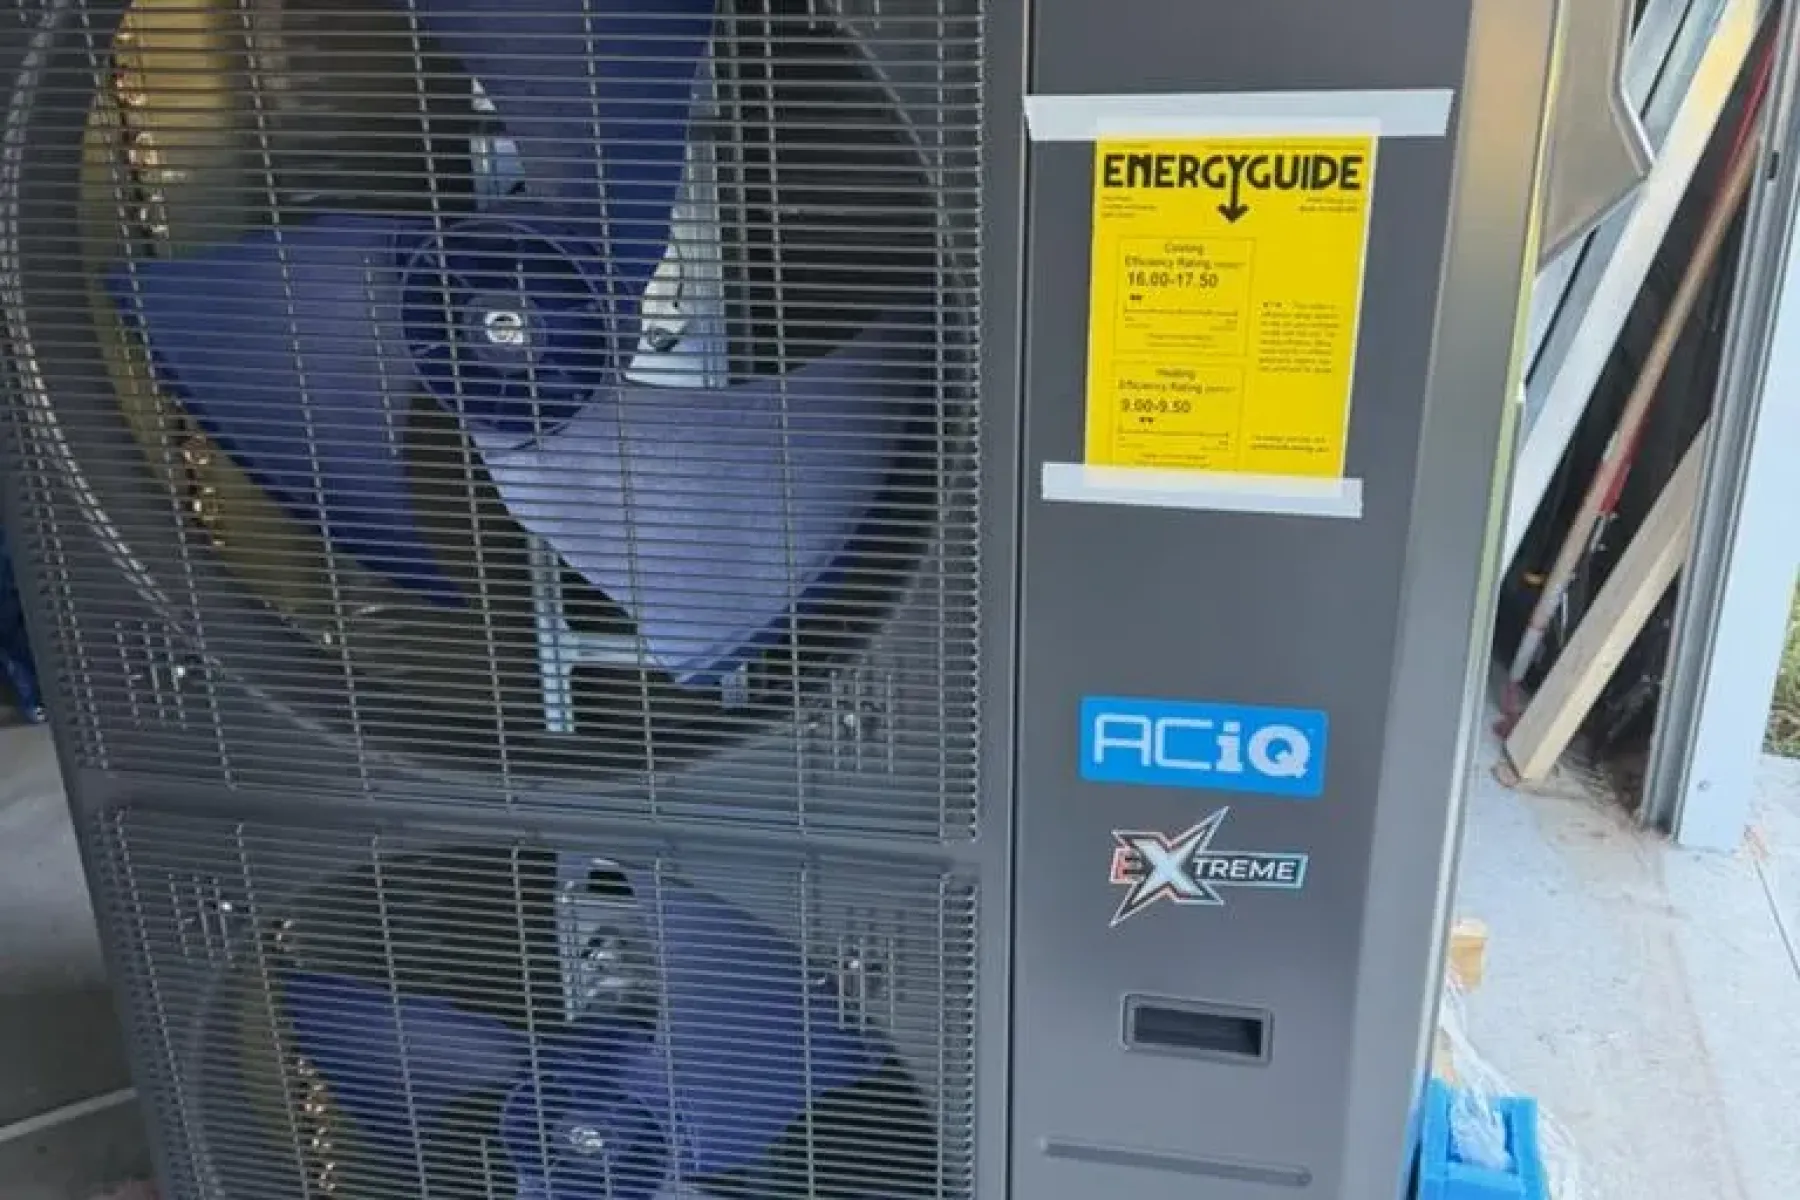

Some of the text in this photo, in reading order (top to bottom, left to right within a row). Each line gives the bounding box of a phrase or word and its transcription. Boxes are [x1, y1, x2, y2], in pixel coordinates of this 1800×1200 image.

[1103, 153, 1363, 194] ENERGYGUIDE
[1164, 243, 1204, 256] Cooling
[1125, 255, 1174, 271] Efficiency
[1176, 257, 1212, 270] Rating
[1156, 368, 1196, 381] Heating
[1118, 379, 1167, 392] Efficiency
[1170, 381, 1203, 395] Rating
[1093, 712, 1311, 779] ACiQ
